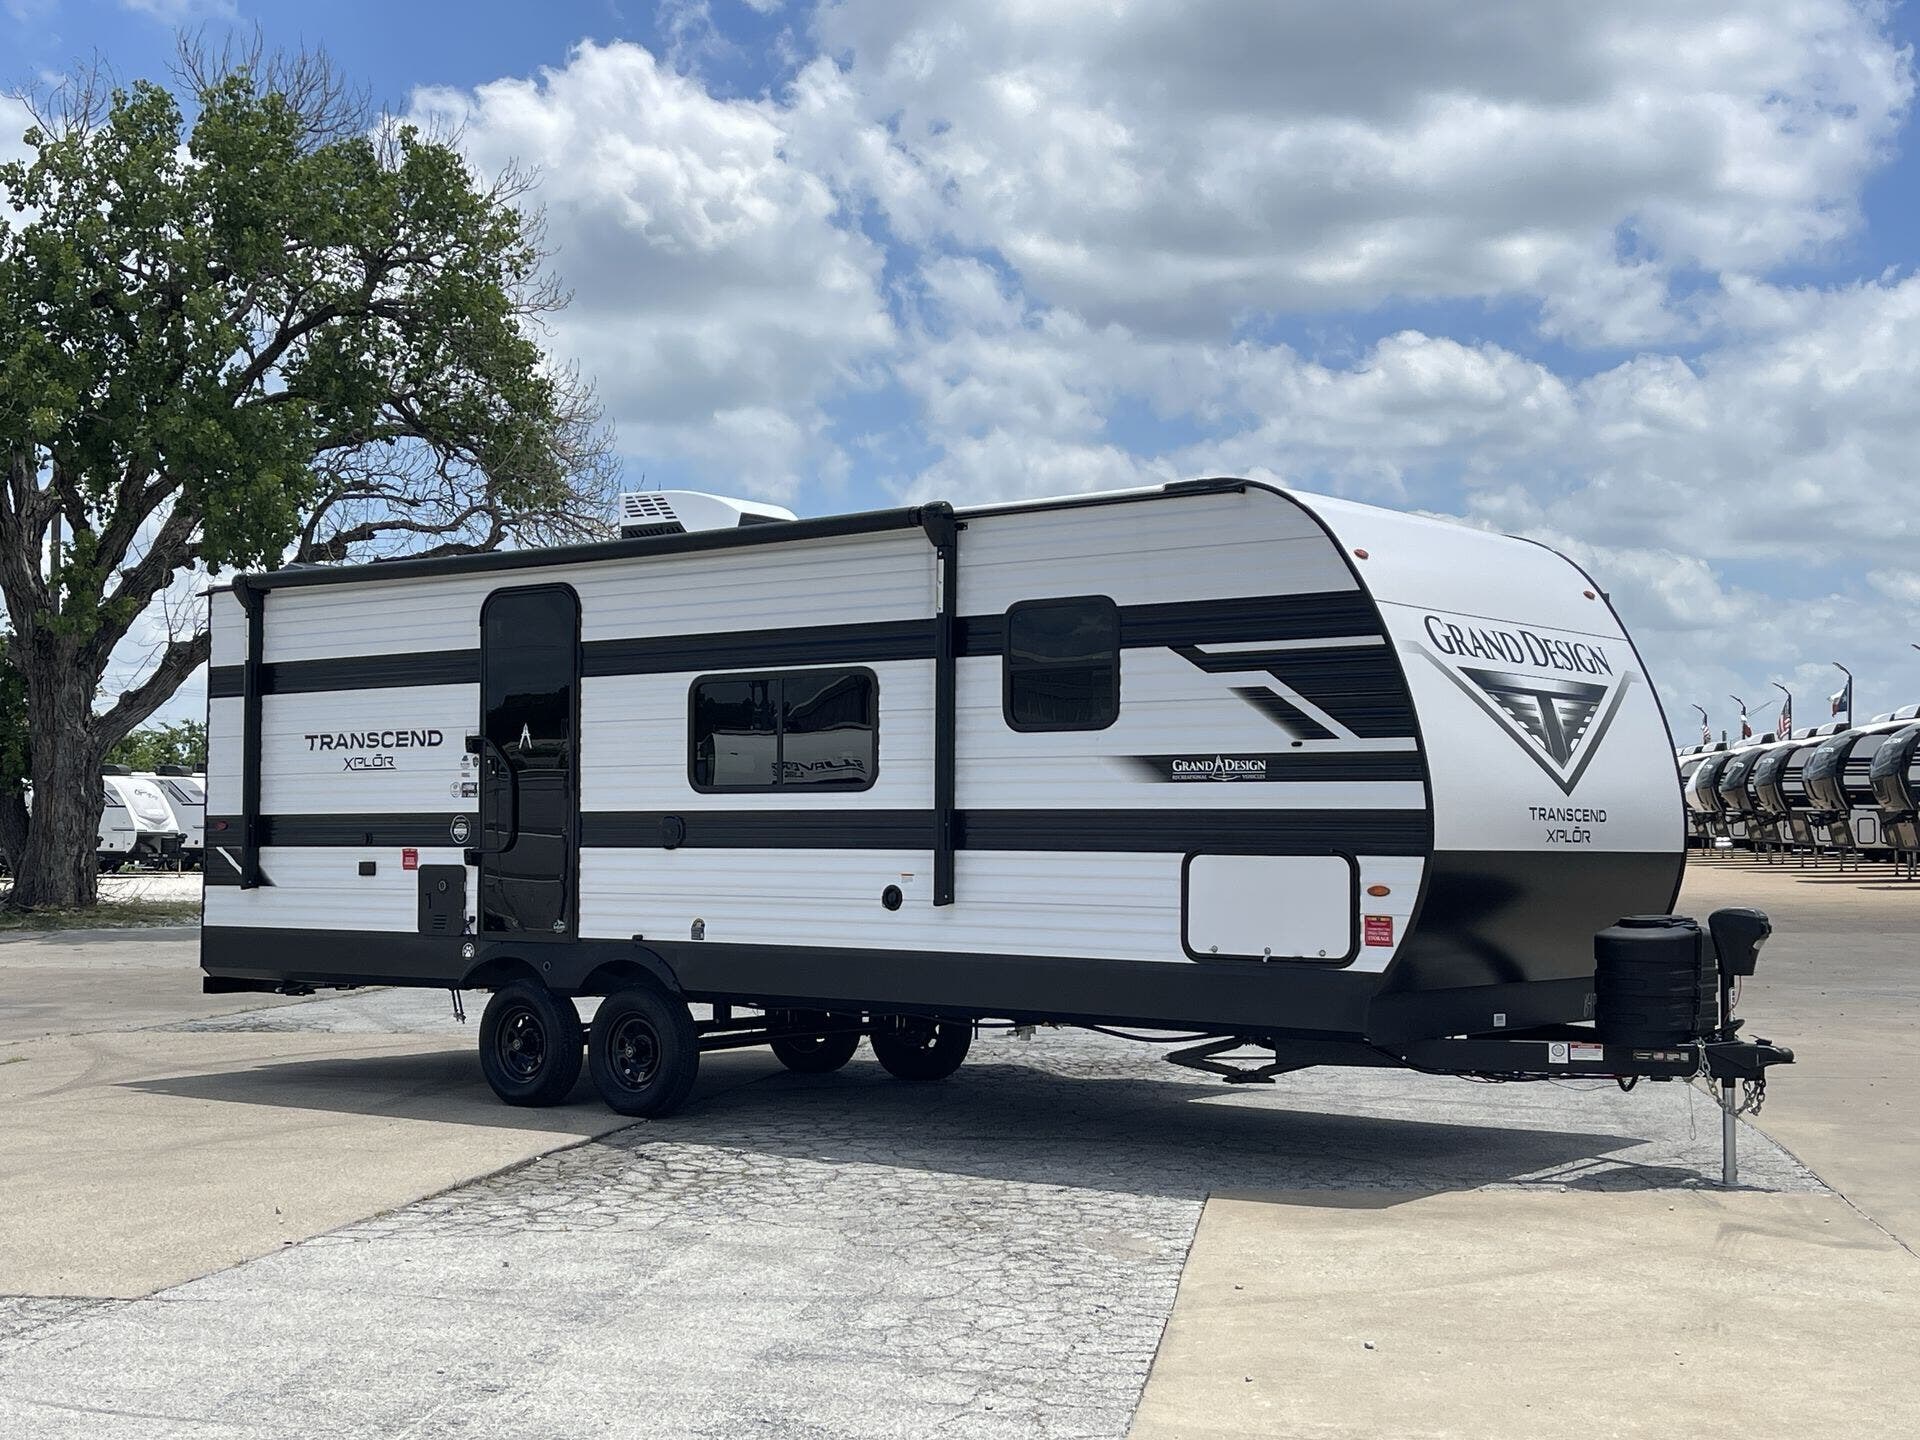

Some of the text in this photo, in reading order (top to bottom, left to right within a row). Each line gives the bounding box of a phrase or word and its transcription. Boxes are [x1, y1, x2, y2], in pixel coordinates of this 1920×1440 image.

[1423, 614, 1614, 677] GRAND DESIGN
[304, 730, 443, 751] TRANSCEND
[1172, 758, 1266, 772] GRAND DESIGN
[1529, 806, 1608, 823] TRANSCEND
